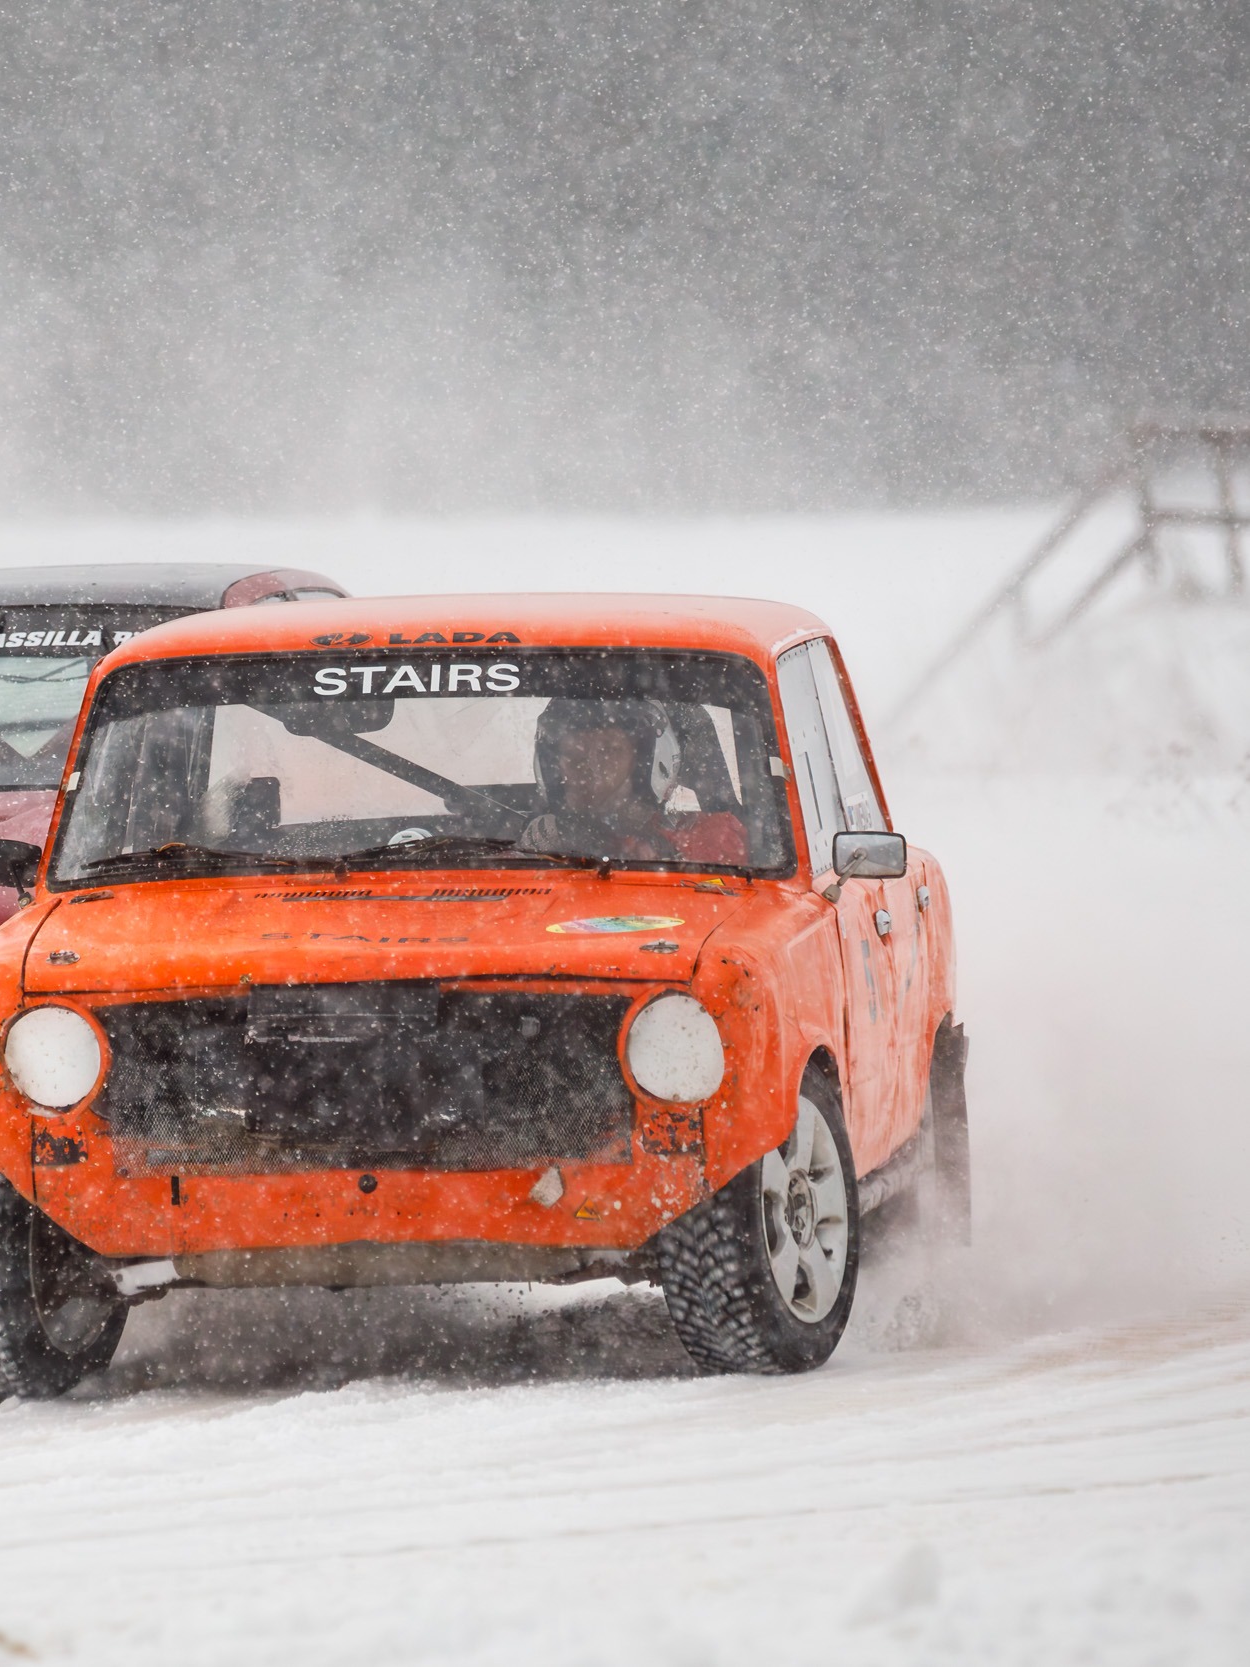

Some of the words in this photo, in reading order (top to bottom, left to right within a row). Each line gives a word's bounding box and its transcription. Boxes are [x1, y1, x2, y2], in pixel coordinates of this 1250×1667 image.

[112, 630, 142, 646] R
[388, 631, 522, 644] LADA
[313, 663, 521, 696] STAIRS
[261, 932, 469, 944] STAIRS
